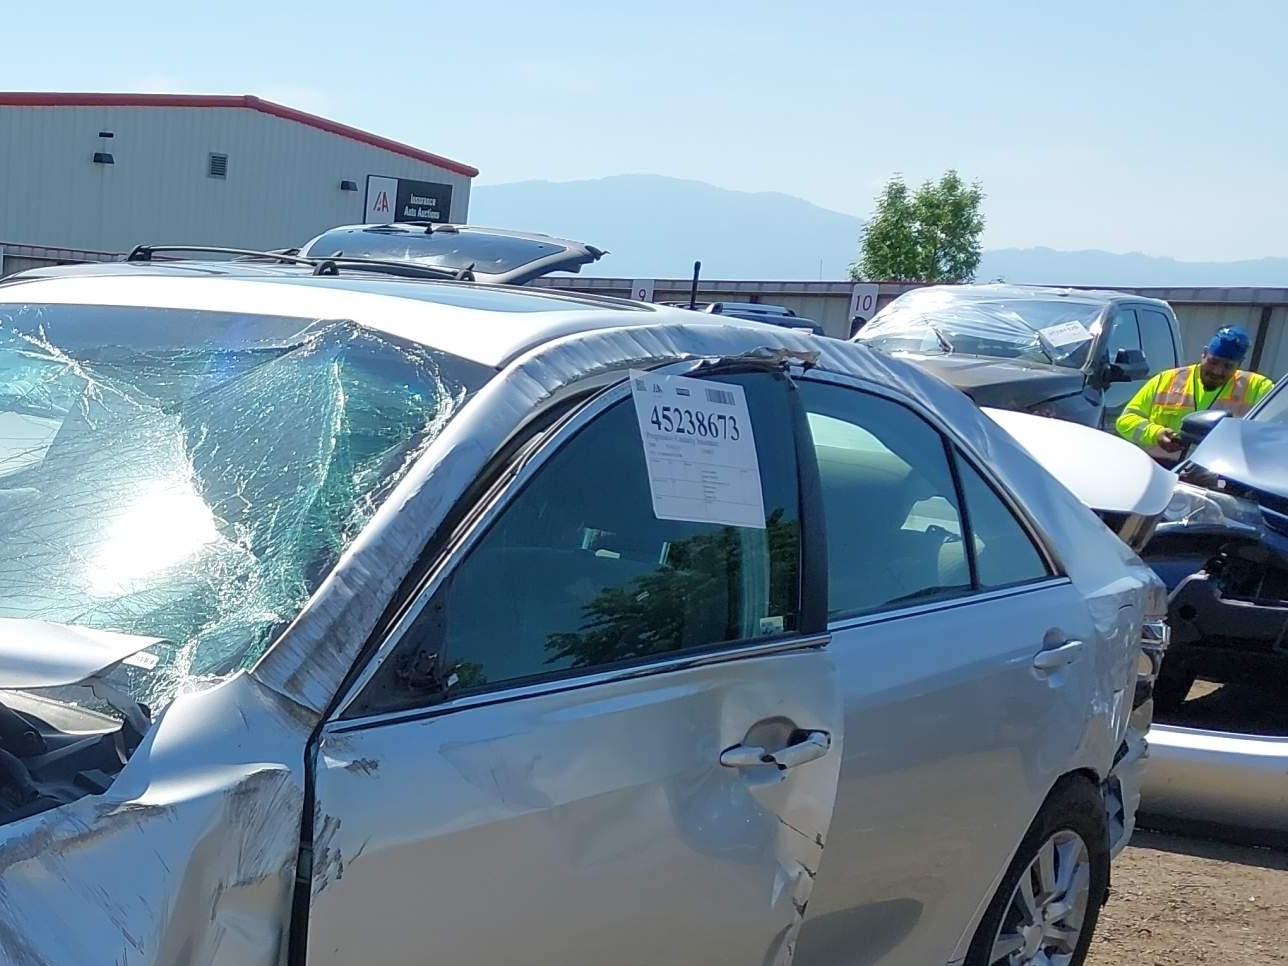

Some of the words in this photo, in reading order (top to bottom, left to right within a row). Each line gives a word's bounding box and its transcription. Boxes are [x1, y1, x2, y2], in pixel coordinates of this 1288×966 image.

[410, 193, 436, 206] Insurance
[403, 205, 417, 217] Auto
[417, 206, 440, 219] Auctions
[638, 288, 646, 302] 9
[855, 295, 872, 311] 10
[650, 405, 740, 441] 45238673
